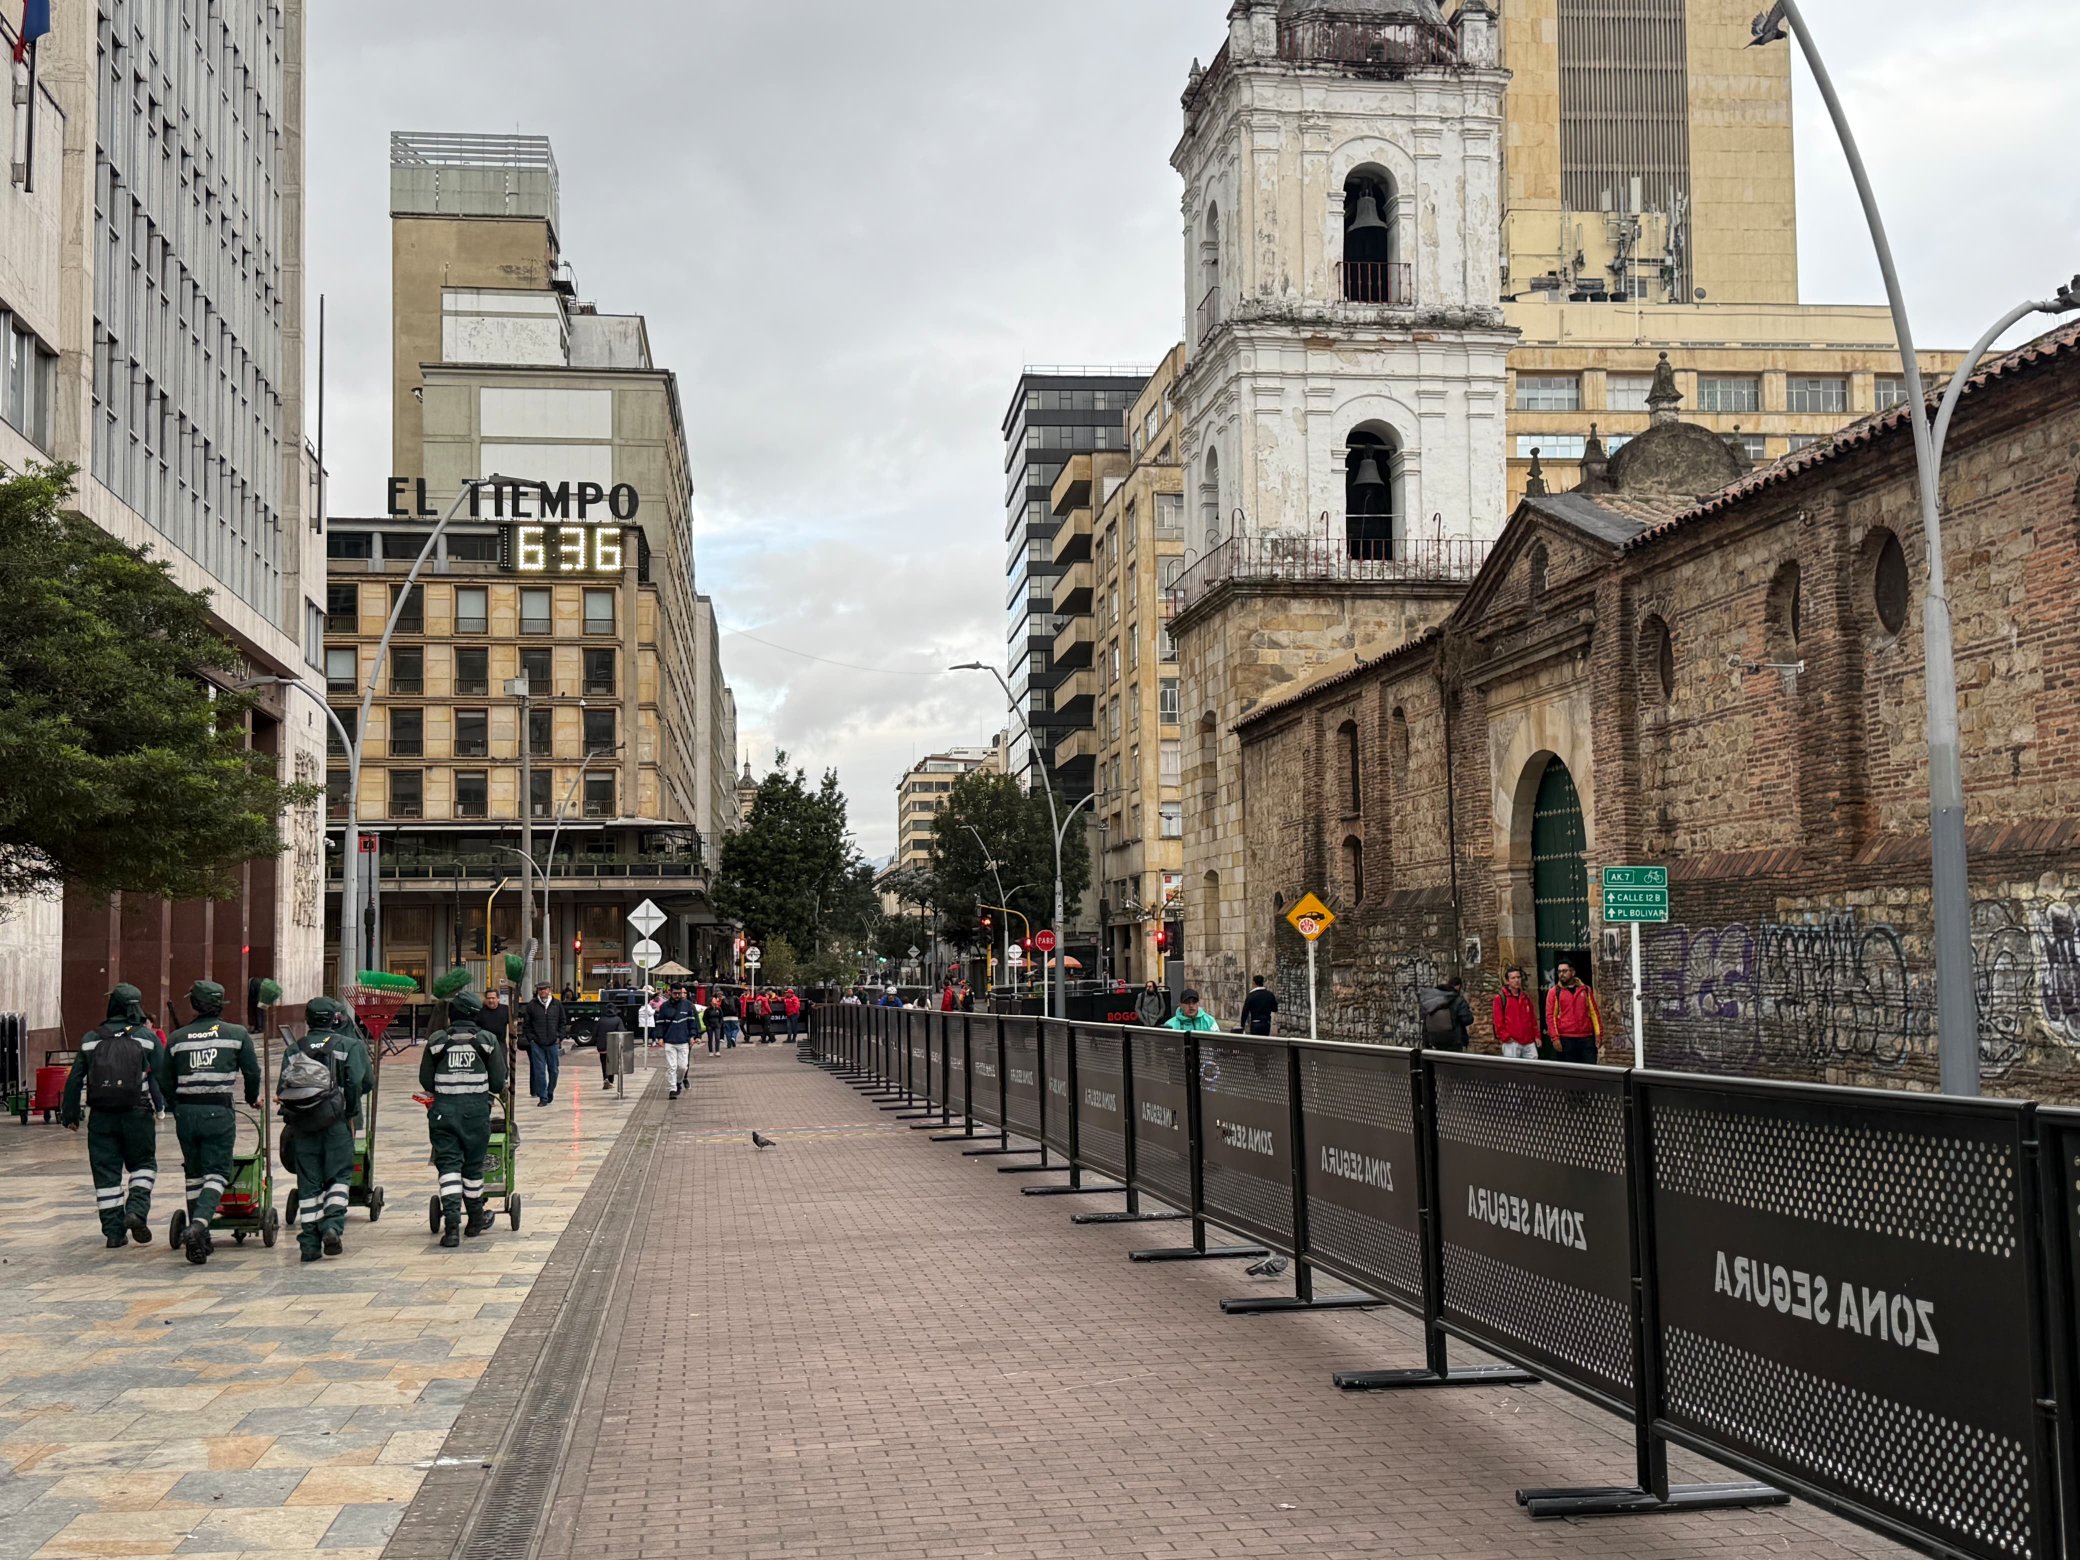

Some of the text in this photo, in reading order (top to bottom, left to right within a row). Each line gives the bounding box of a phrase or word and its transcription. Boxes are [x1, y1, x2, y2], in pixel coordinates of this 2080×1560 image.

[388, 477, 639, 520] EL TIEMPO
[1617, 893, 1661, 902] CALLE 12 B
[1617, 909, 1629, 917] PL
[1037, 937, 1054, 945] PARE
[448, 1052, 476, 1068] UAESP
